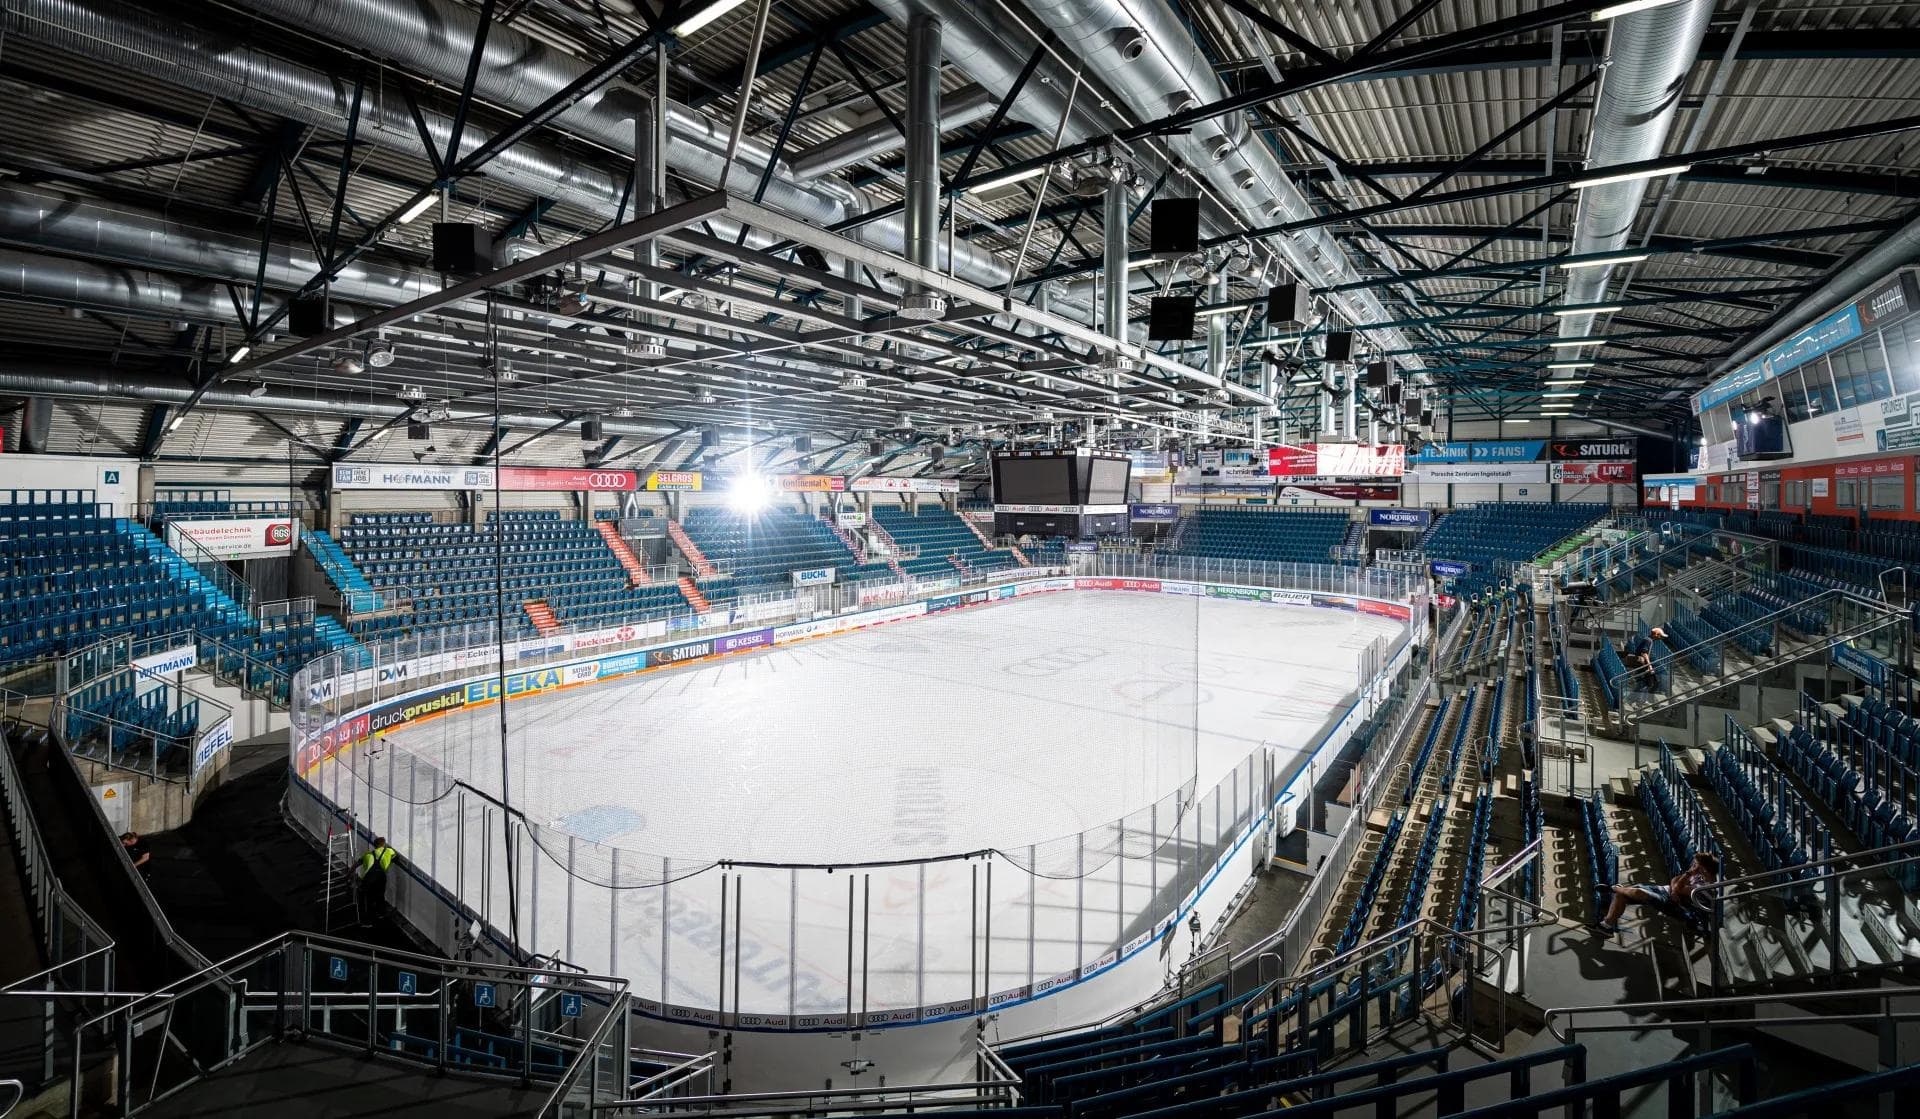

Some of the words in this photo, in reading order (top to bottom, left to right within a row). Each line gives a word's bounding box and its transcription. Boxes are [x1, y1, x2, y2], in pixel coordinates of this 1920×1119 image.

[1492, 446, 1525, 456] FANS!
[1580, 444, 1630, 455] SATURN
[1603, 466, 1624, 476] LIVE
[107, 473, 118, 483] A
[657, 473, 693, 483] SELGROS
[783, 478, 821, 488] Continental
[273, 529, 289, 538] RGS
[739, 635, 764, 646] KESSEL
[467, 648, 499, 658] Eckele
[672, 643, 709, 661] SATURN
[379, 664, 407, 681] DVM
[468, 669, 560, 700] EDEKA
[196, 731, 233, 767] IEFEL
[1099, 956, 1114, 966] Audi
[1055, 975, 1074, 986] Audi
[1007, 987, 1027, 999] Audi
[638, 1000, 657, 1012] Audi
[949, 1003, 970, 1013] Audi
[693, 1012, 714, 1021] Audi
[891, 1012, 915, 1020] Audi
[764, 1017, 787, 1026] Audi
[823, 1018, 846, 1026] Audi
